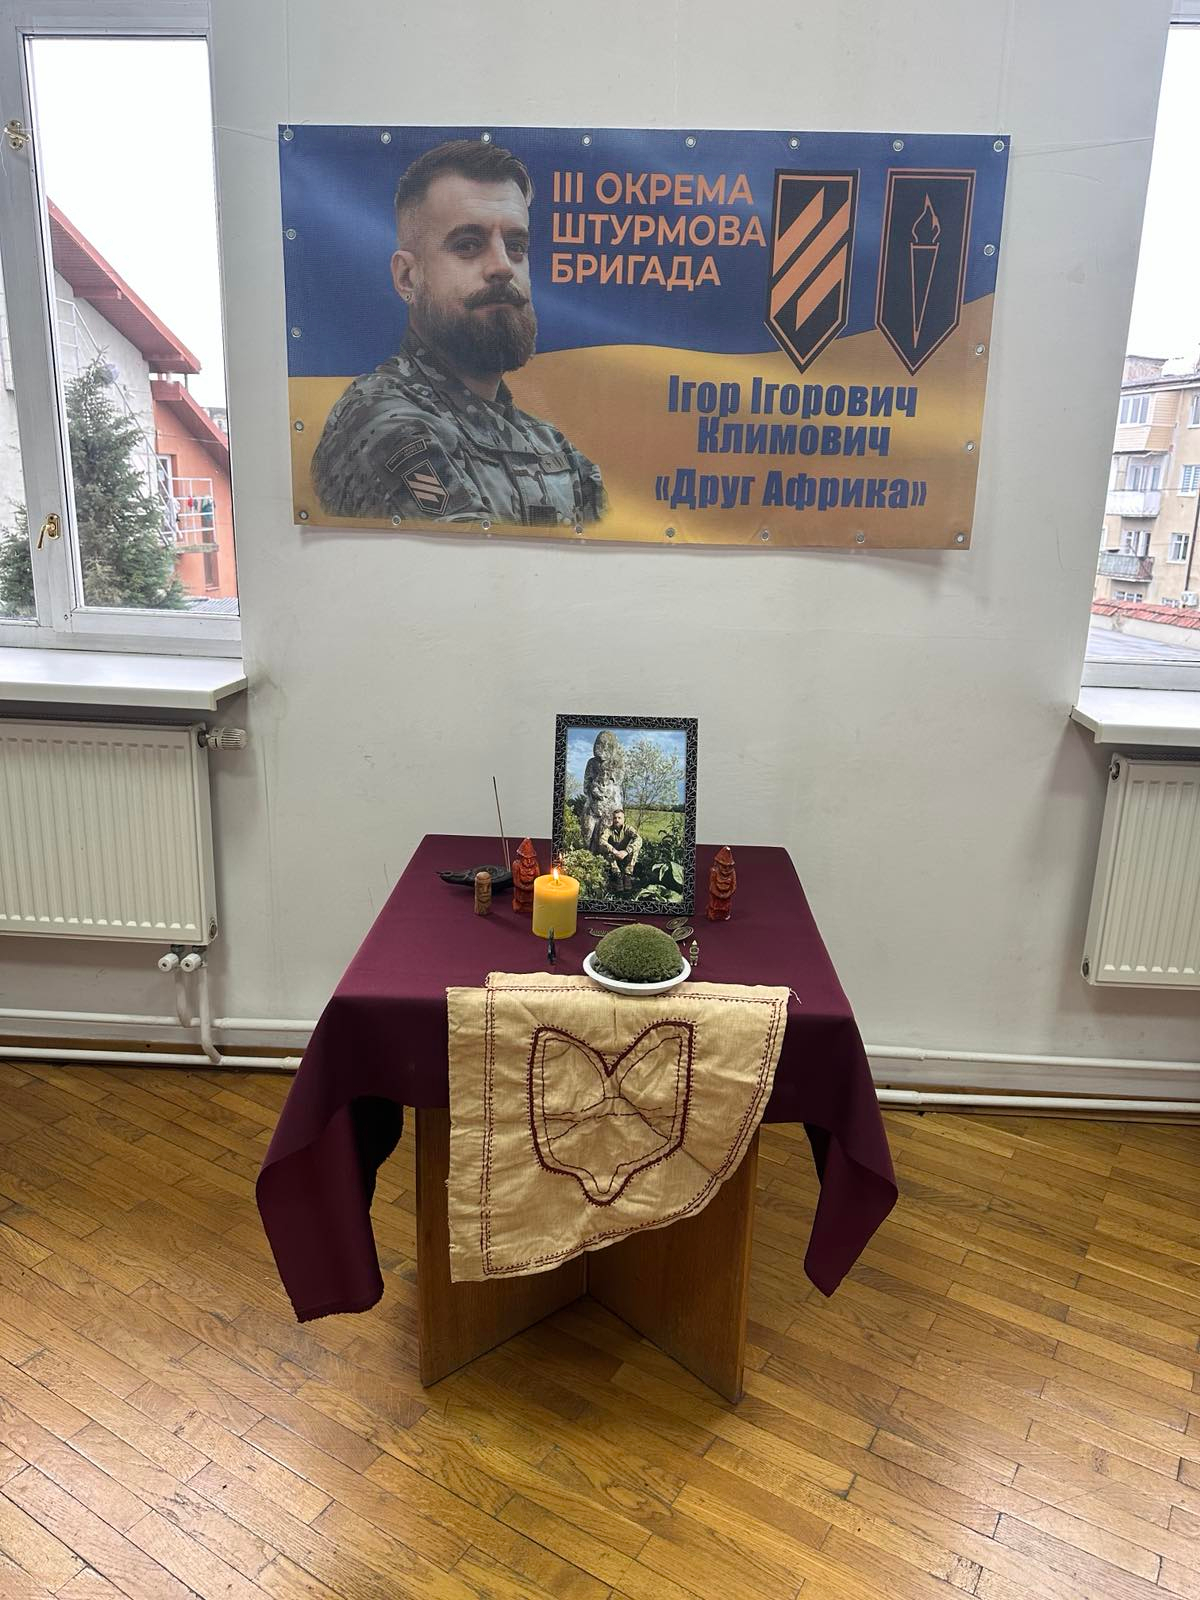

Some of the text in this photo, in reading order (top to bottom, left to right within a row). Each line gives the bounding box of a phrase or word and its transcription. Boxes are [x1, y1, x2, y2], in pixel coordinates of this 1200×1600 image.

[595, 171, 753, 206] ОКРЕМА
[552, 212, 766, 247] ШТУРМОВА
[551, 252, 721, 291] БРИГАДА
[668, 375, 918, 419] Ігор Ігорович
[697, 416, 891, 457] Климович
[655, 468, 927, 511] «Друг Африка»
